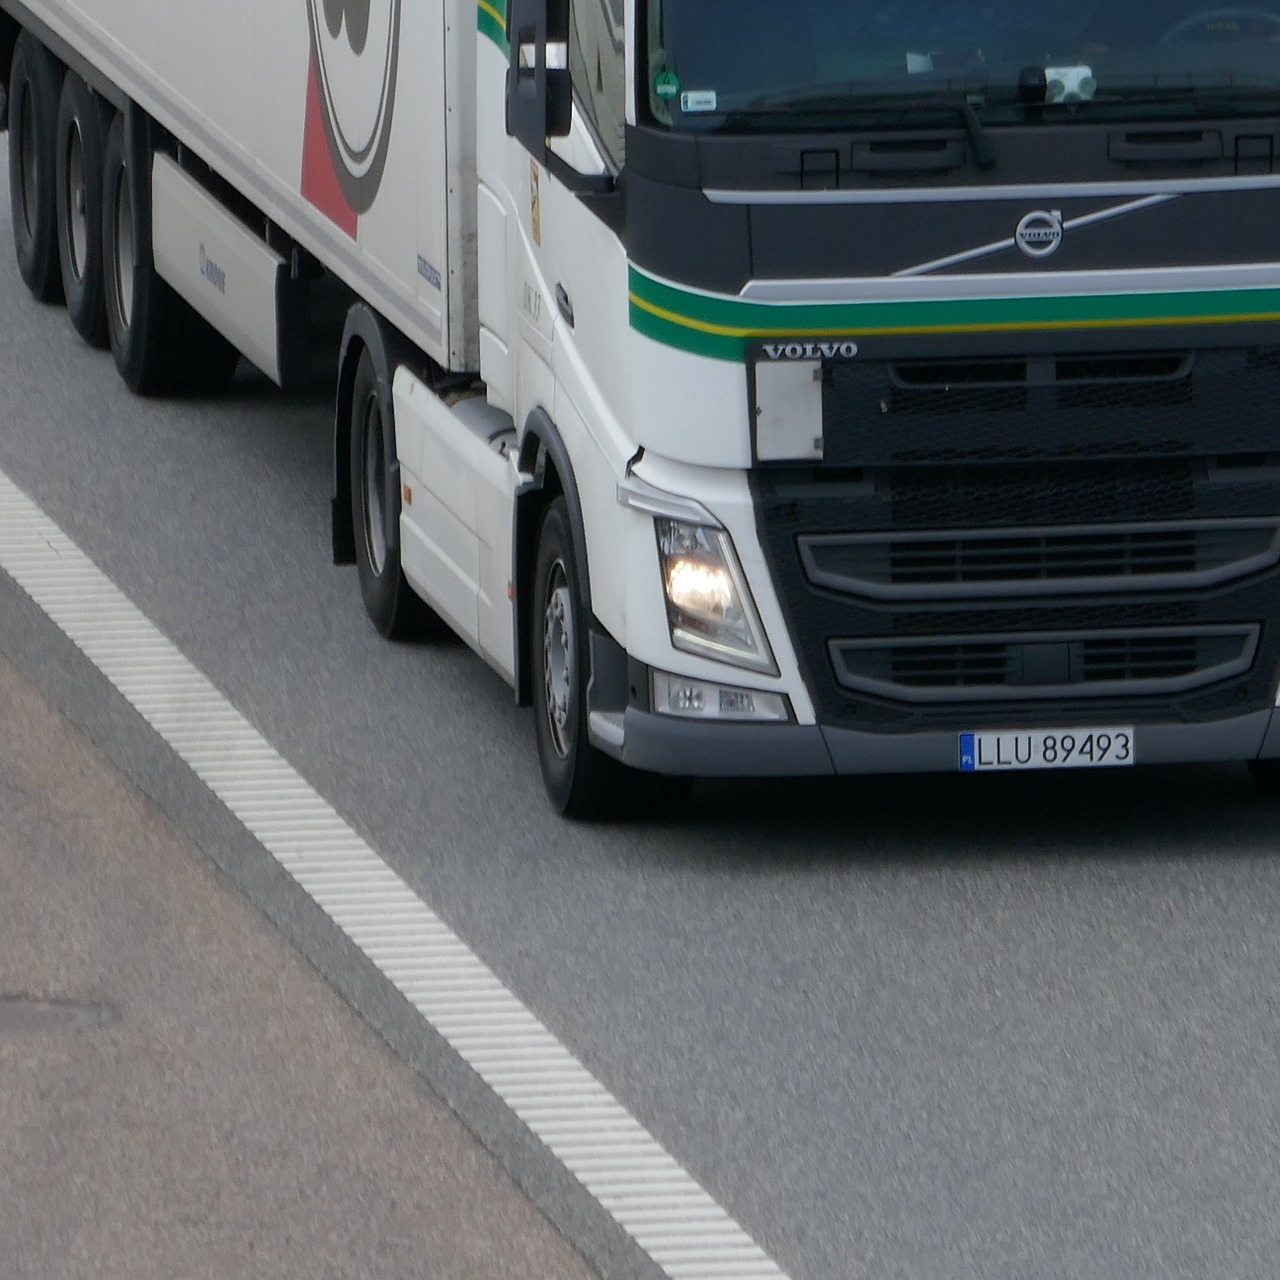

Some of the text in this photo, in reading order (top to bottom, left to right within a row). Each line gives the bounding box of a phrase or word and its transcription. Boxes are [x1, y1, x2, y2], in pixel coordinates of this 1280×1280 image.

[762, 341, 859, 360] VOLVO
[977, 736, 1032, 766] LLU
[1042, 733, 1130, 763] 89493
